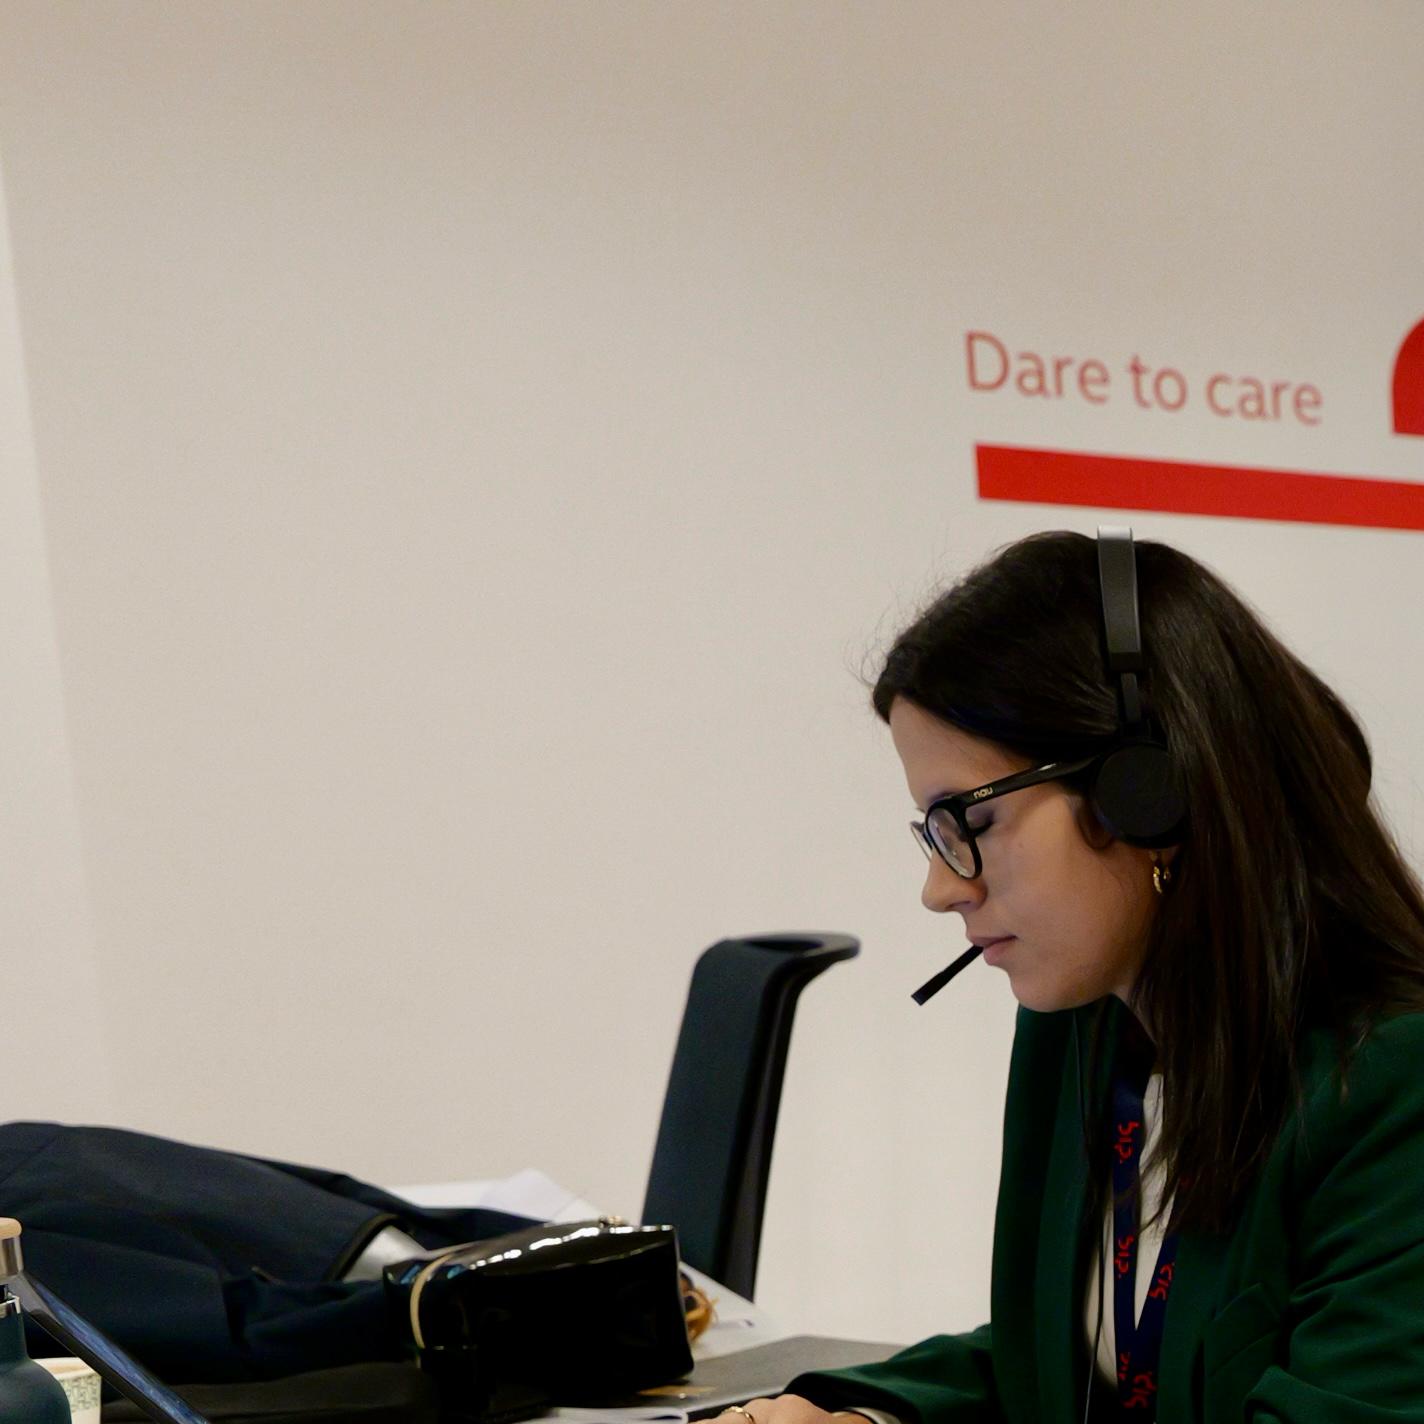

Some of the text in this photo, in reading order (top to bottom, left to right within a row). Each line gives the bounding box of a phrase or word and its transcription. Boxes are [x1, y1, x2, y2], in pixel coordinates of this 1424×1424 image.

[965, 331, 1323, 426] Dare to care
